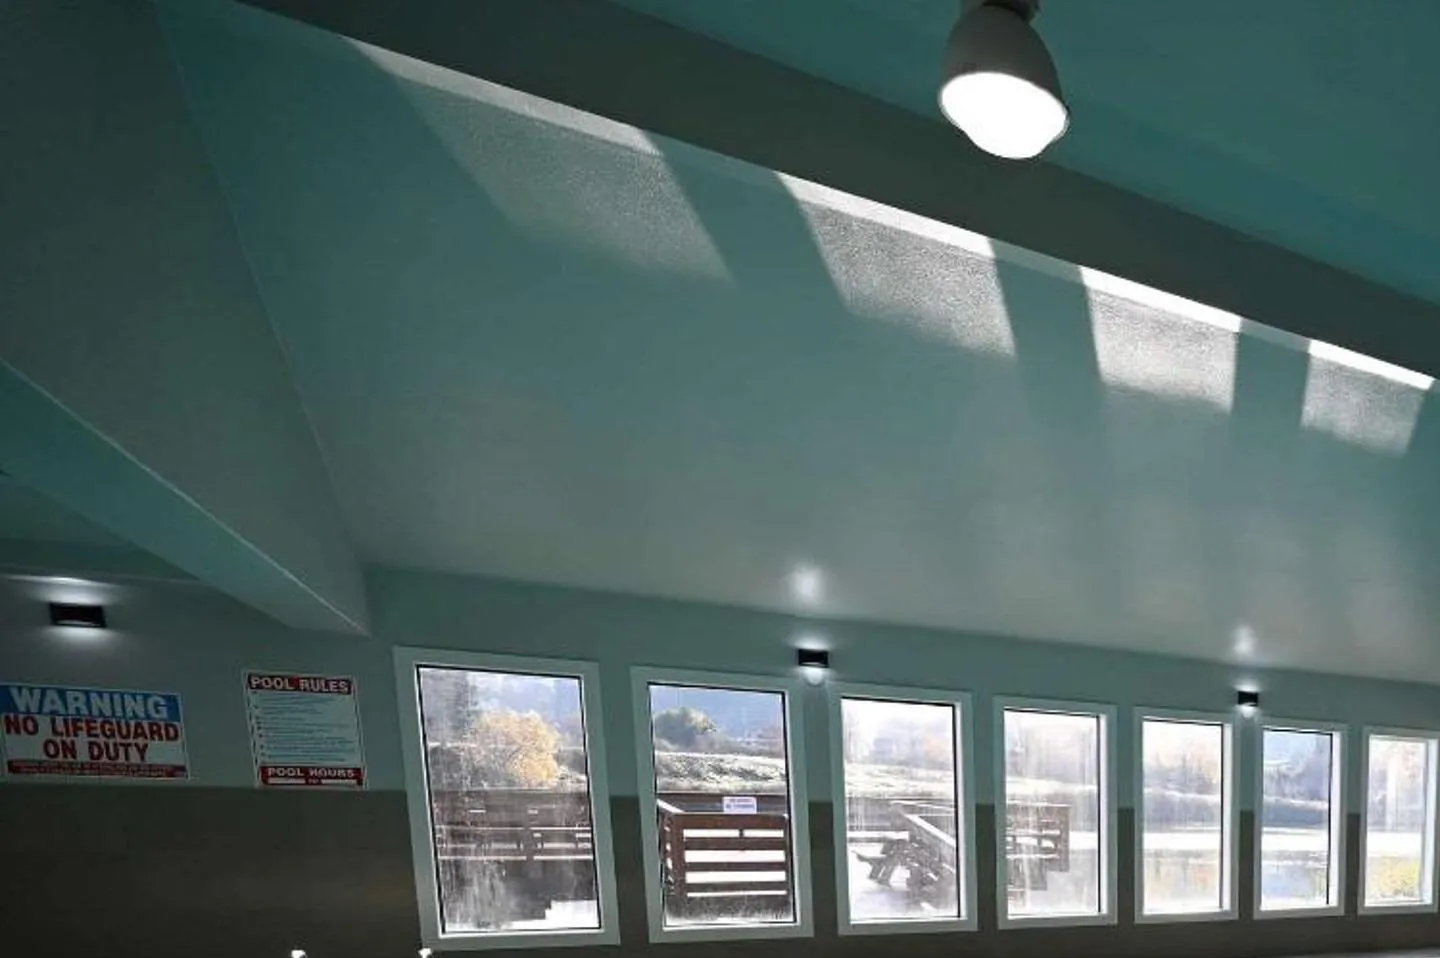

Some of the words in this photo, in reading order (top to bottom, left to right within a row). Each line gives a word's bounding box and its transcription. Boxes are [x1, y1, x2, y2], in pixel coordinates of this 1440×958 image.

[250, 676, 296, 690] POOL
[299, 678, 349, 693] RULES
[8, 685, 169, 719] WARNING
[3, 713, 39, 736] NO
[51, 717, 179, 742] LIFEGUARD
[43, 738, 77, 760] ON
[88, 740, 149, 762] DUTY
[267, 767, 305, 778] POOL
